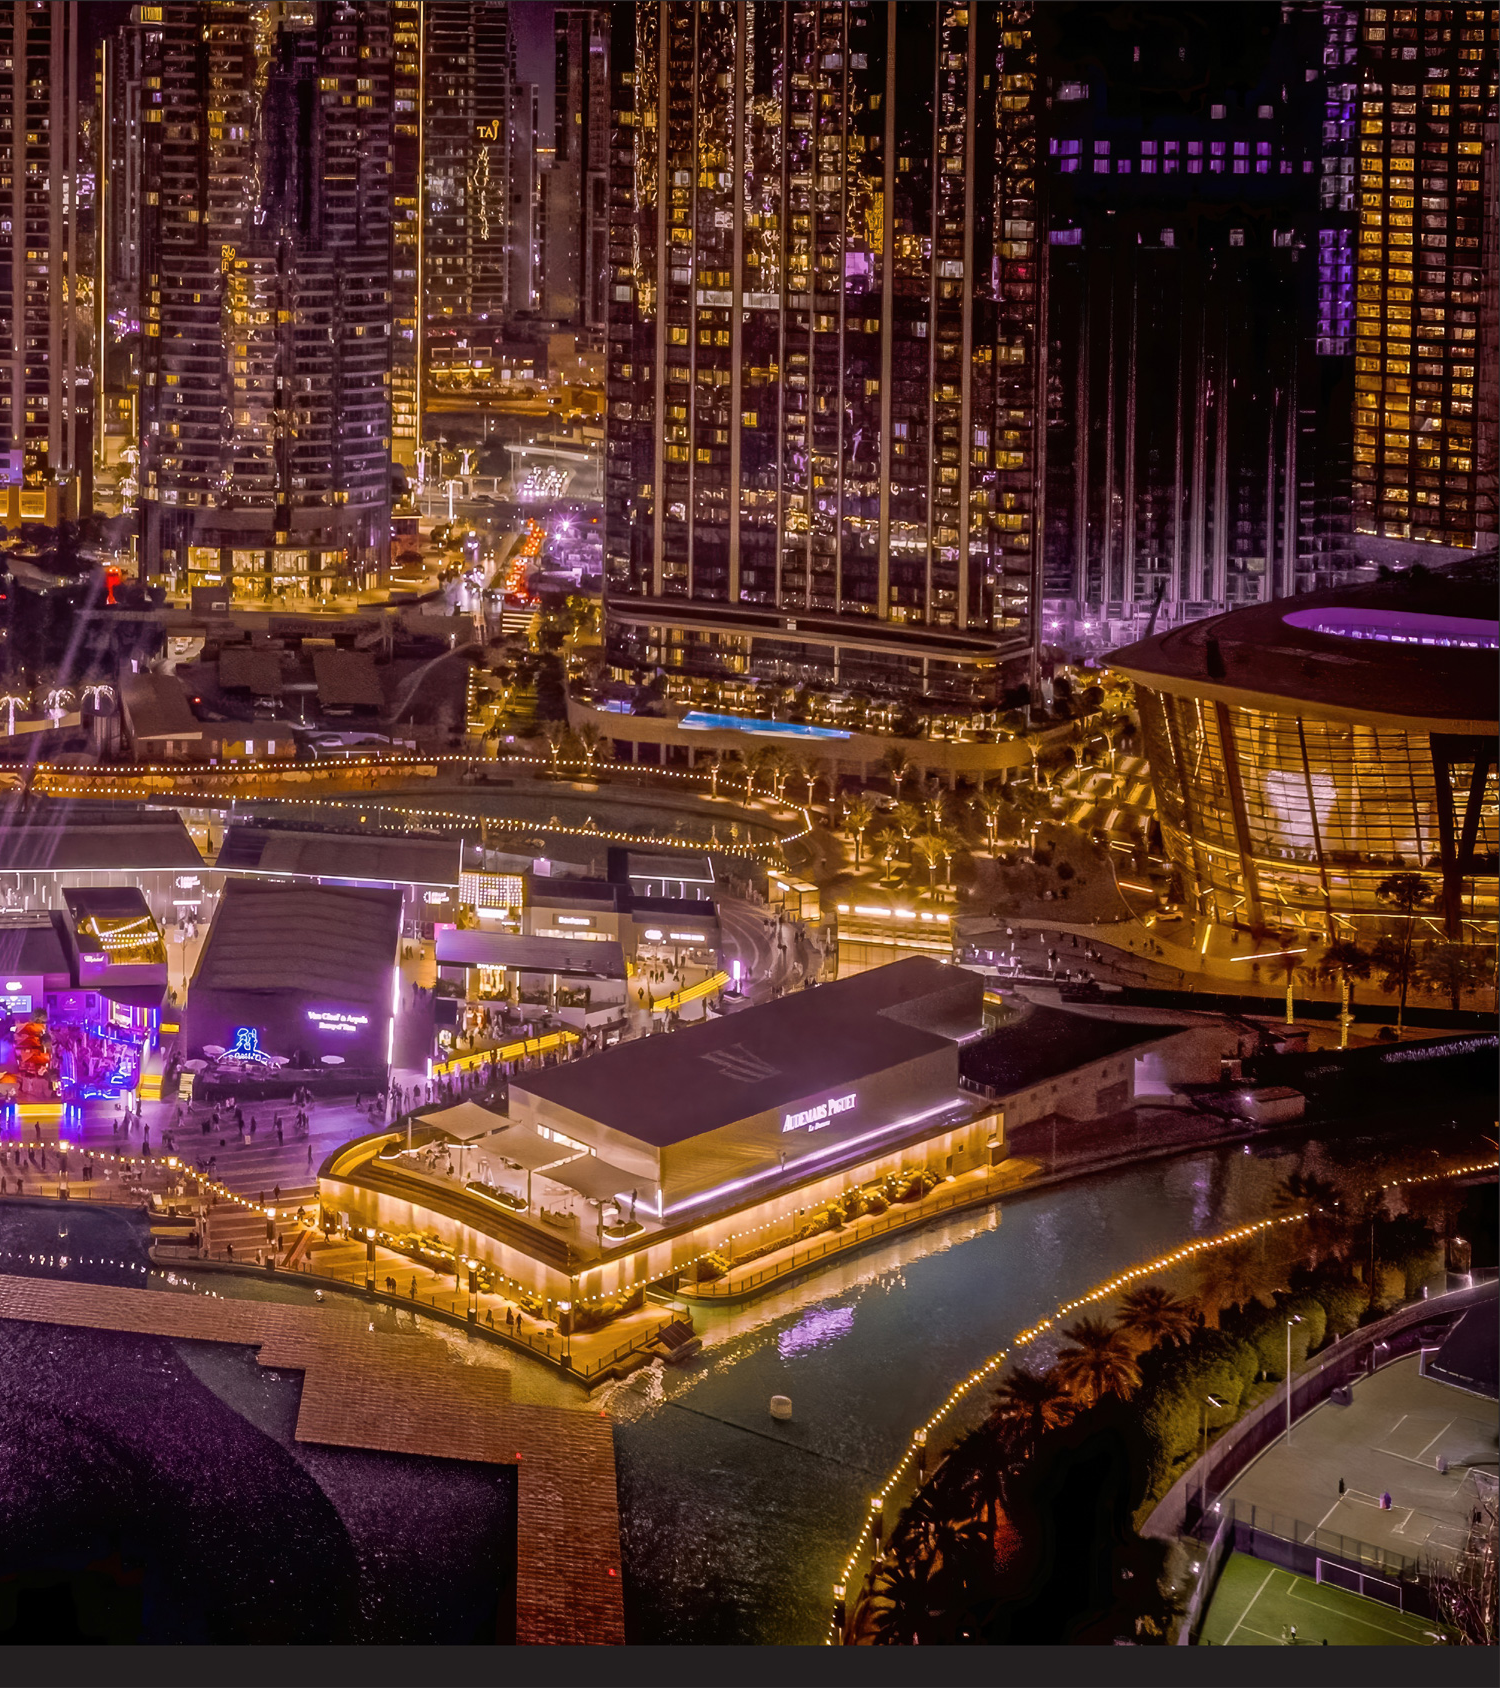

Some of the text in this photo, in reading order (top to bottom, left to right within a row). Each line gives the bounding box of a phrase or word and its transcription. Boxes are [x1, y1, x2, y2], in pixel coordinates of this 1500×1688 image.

[477, 120, 499, 140] TAJ
[782, 1104, 827, 1132] AUDEMARS
[827, 1093, 857, 1117] PIGUET
